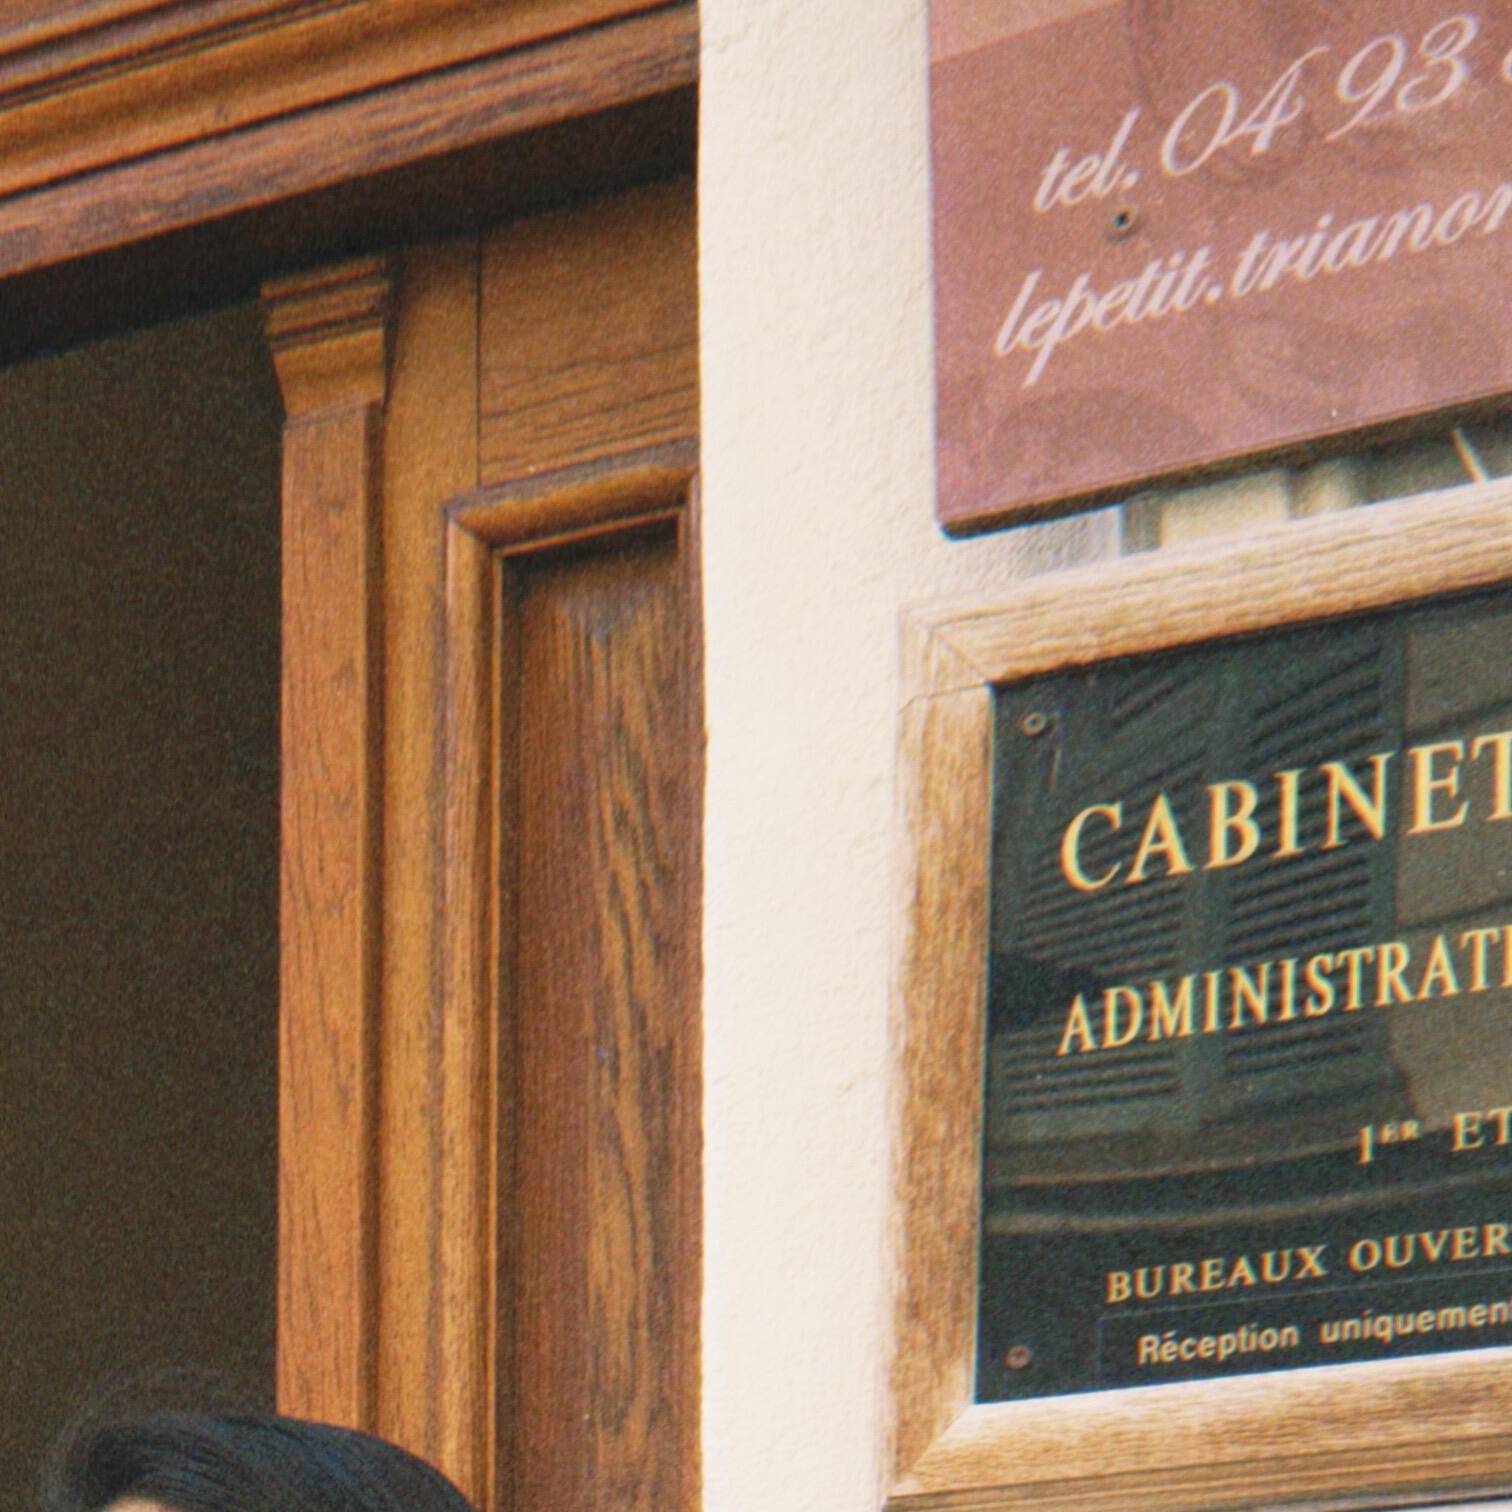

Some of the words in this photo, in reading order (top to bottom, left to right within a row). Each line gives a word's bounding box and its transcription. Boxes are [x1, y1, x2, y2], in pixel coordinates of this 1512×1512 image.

[1033, 104, 1142, 214] tel.
[1160, 43, 1332, 177] 04
[1324, 14, 1481, 144] 93
[1059, 730, 1512, 892] CABINET
[1105, 1243, 1330, 1304] BUREAUX
[1136, 1321, 1301, 1366] Réception
